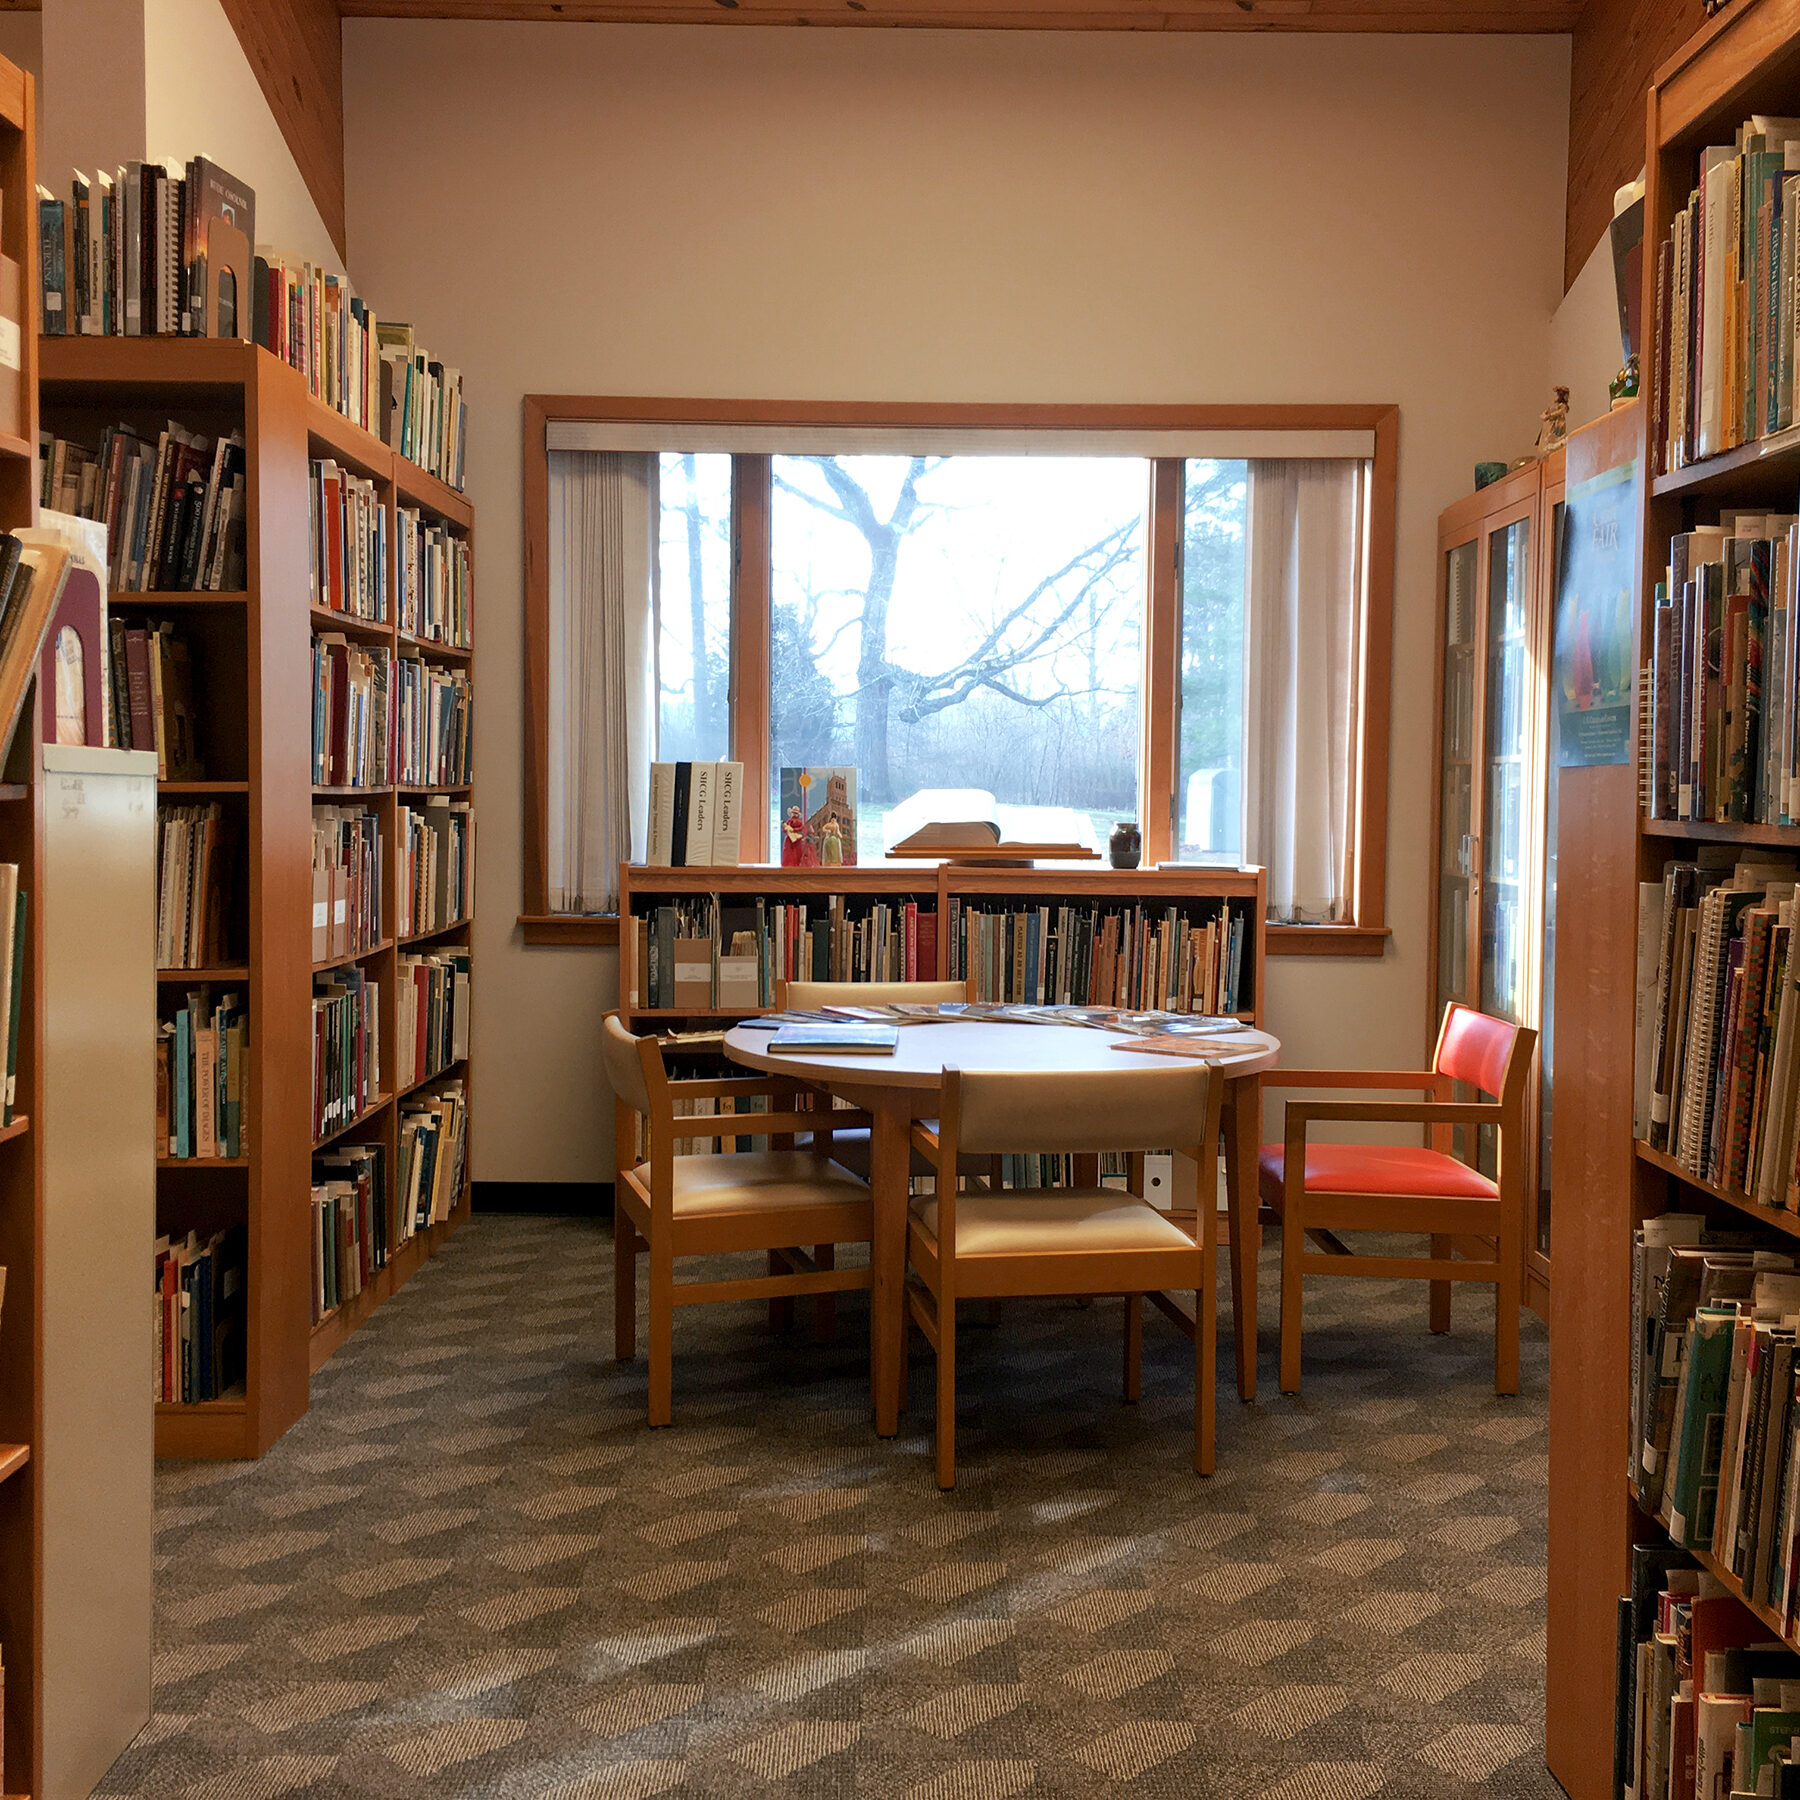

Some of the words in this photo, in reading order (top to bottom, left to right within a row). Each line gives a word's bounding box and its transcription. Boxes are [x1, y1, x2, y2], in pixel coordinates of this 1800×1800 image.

[1771, 226, 1779, 265] stitch
[194, 500, 202, 515] 500
[1671, 597, 1683, 681] Knitting
[699, 770, 708, 798] SHCG
[723, 771, 733, 798] SHCG
[697, 799, 706, 832] Leaders
[722, 800, 731, 832] Leaders
[201, 1051, 210, 1068] THE
[201, 1069, 209, 1098] POWER
